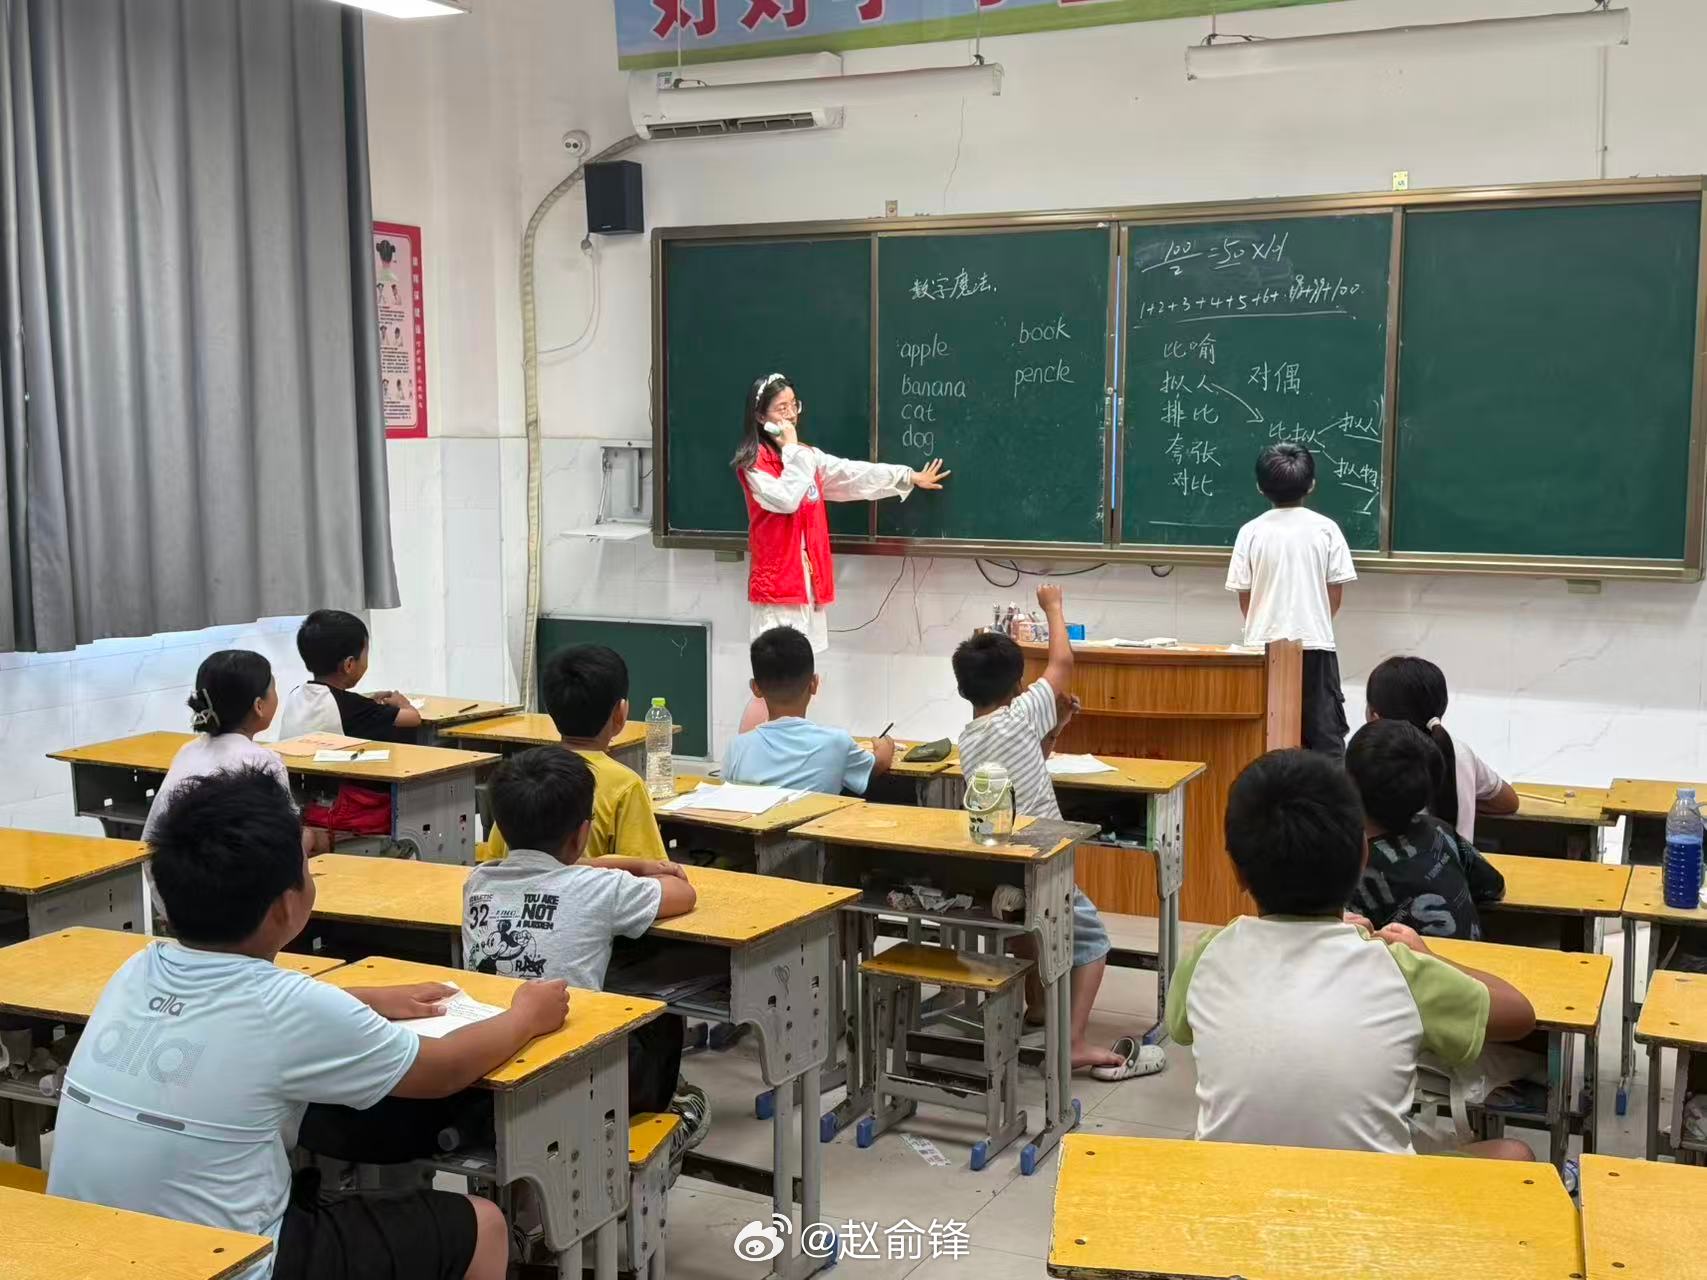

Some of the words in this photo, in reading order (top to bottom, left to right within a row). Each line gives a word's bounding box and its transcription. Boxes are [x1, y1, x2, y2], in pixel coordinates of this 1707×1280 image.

[1019, 315, 1072, 344] book
[900, 332, 951, 368] apple
[1163, 332, 1217, 365] 比喻
[901, 374, 967, 399] banana
[1013, 358, 1075, 398] pencle
[1159, 370, 1214, 394] 拟人
[1247, 360, 1301, 395] 对偶
[901, 402, 936, 422] cat
[1160, 394, 1220, 428] 排比
[902, 424, 935, 457] dog
[1165, 432, 1222, 467] 夸张
[1169, 467, 1213, 497] 对比
[1333, 457, 1378, 488] 拟物
[521, 903, 557, 921] NOT
[524, 893, 541, 904] YOU
[541, 894, 560, 906] ARE
[470, 904, 489, 930] 32
